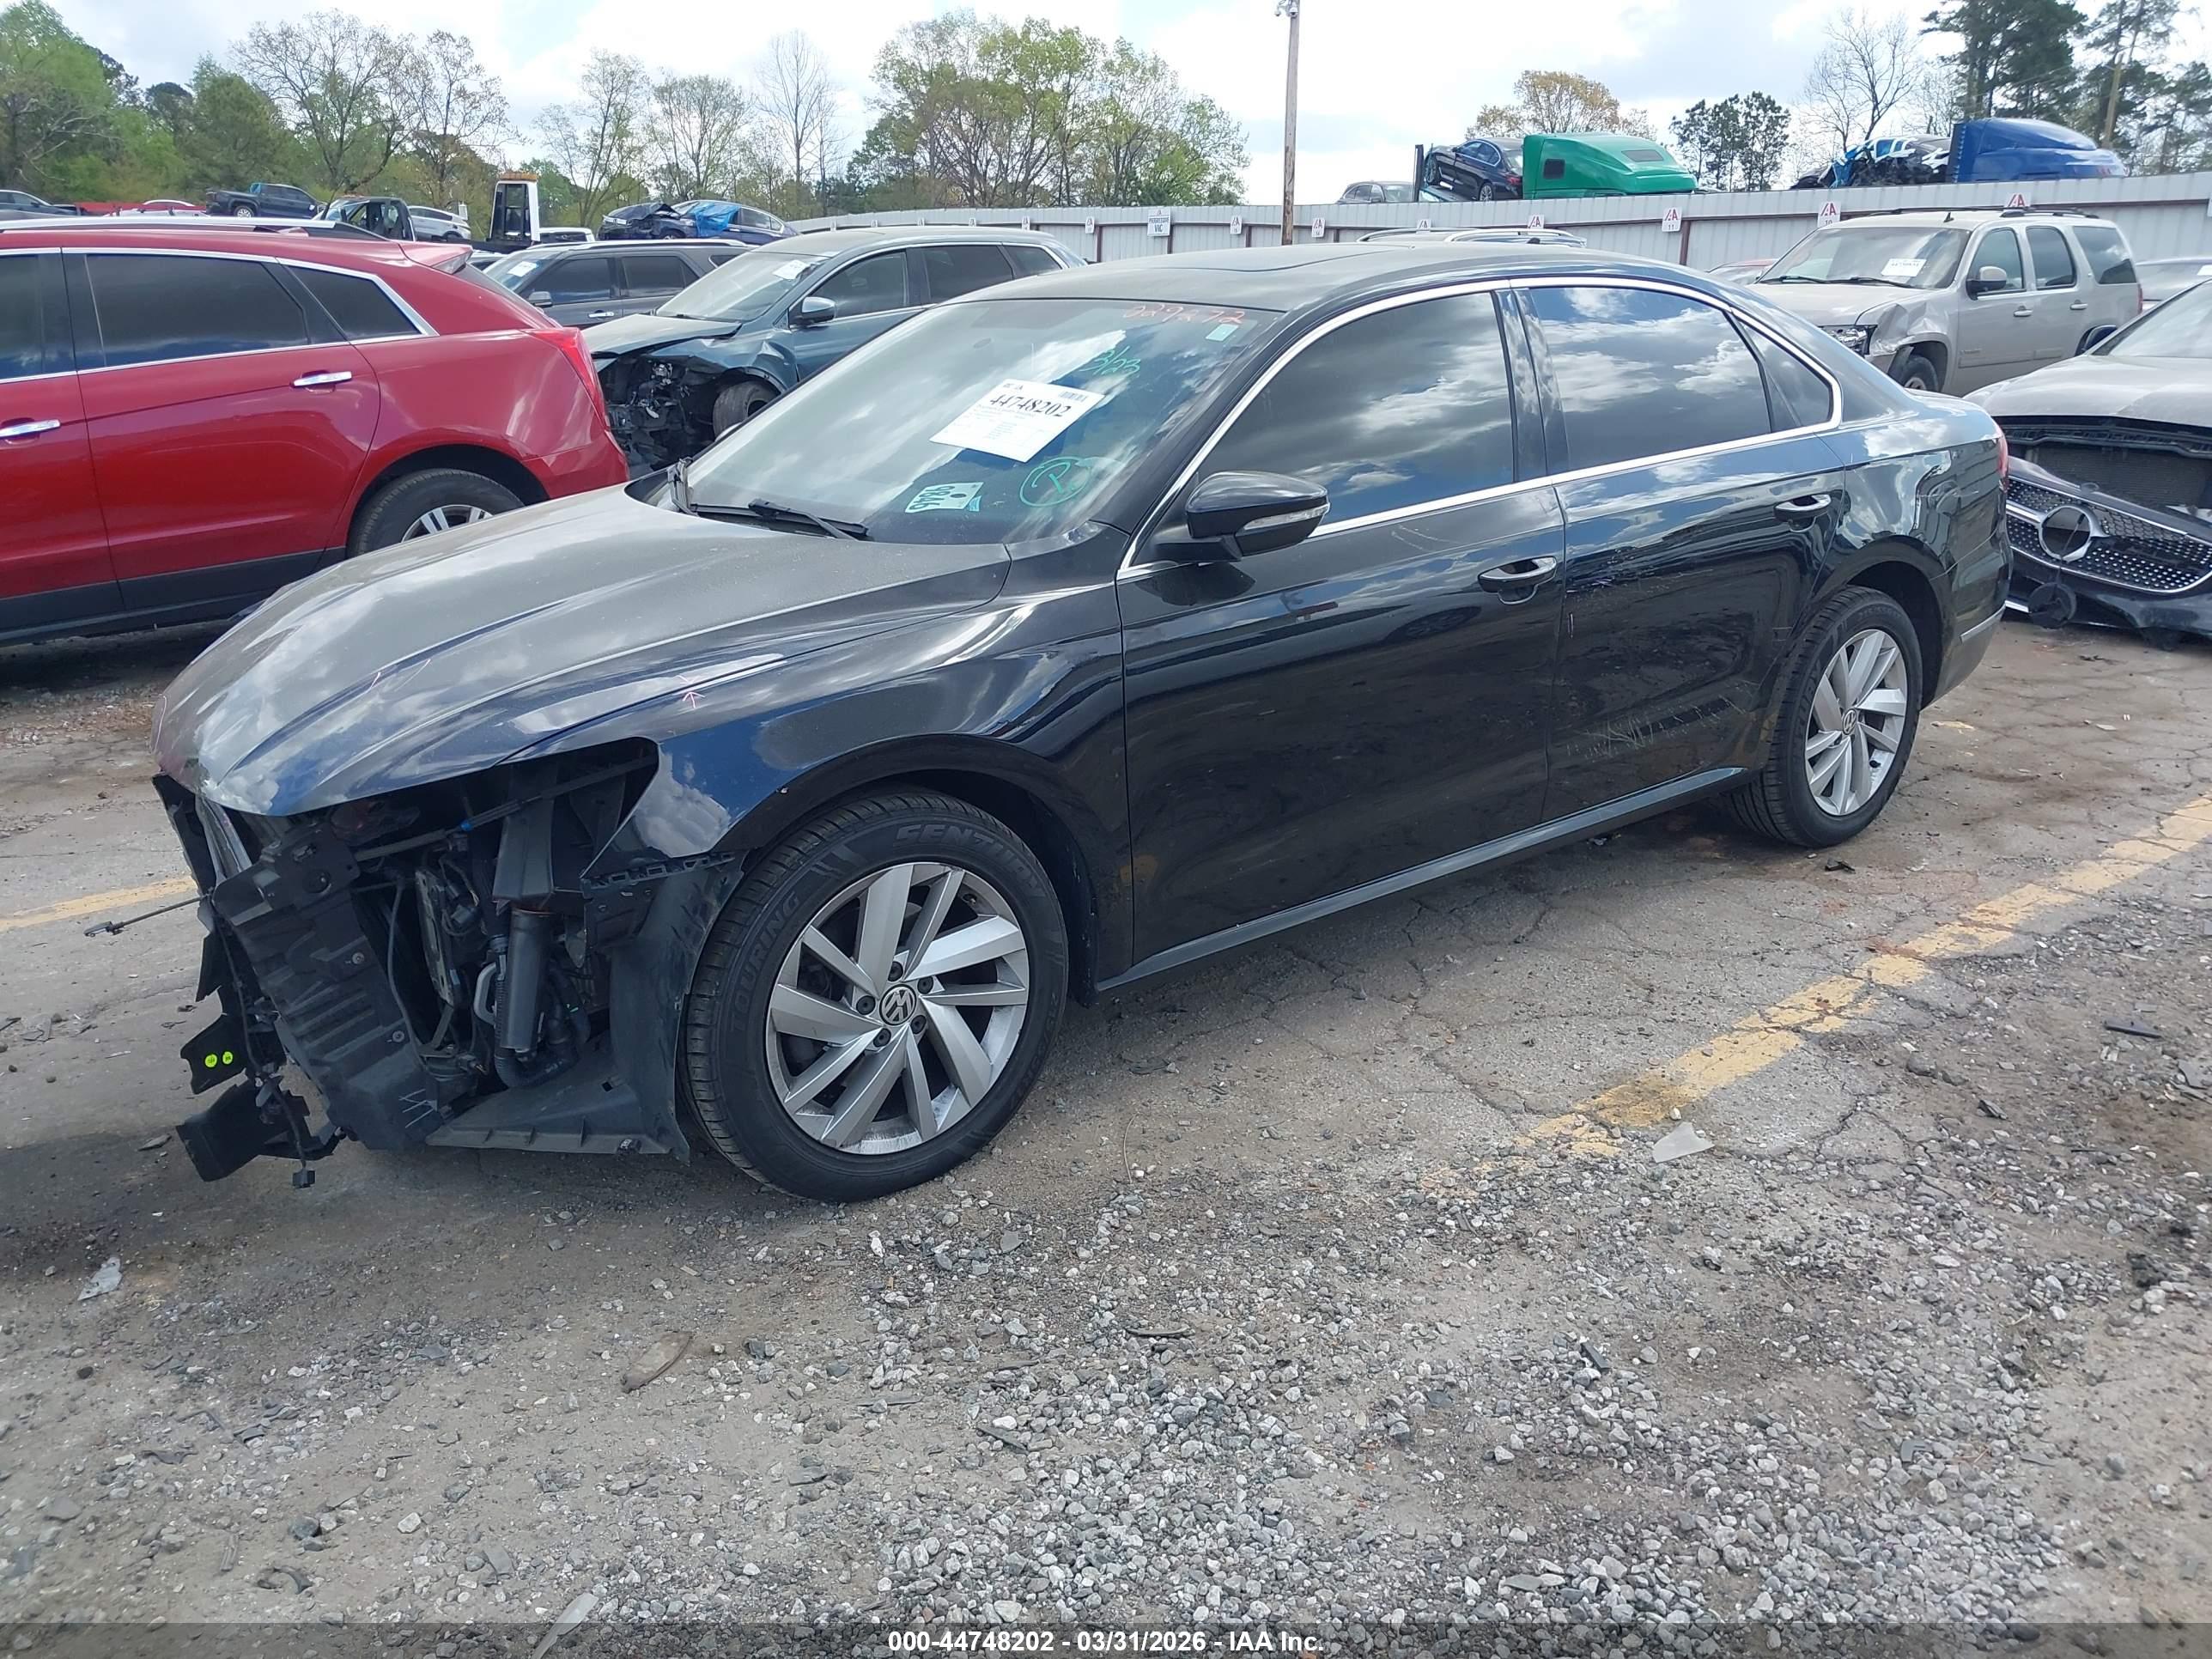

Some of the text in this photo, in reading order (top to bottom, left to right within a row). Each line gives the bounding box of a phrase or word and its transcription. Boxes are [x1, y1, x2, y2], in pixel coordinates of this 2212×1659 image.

[1154, 224, 1164, 233] VIC
[1079, 345, 1141, 377] 3/23
[989, 394, 1072, 417] 44748202
[732, 890, 799, 1032] TOURING
